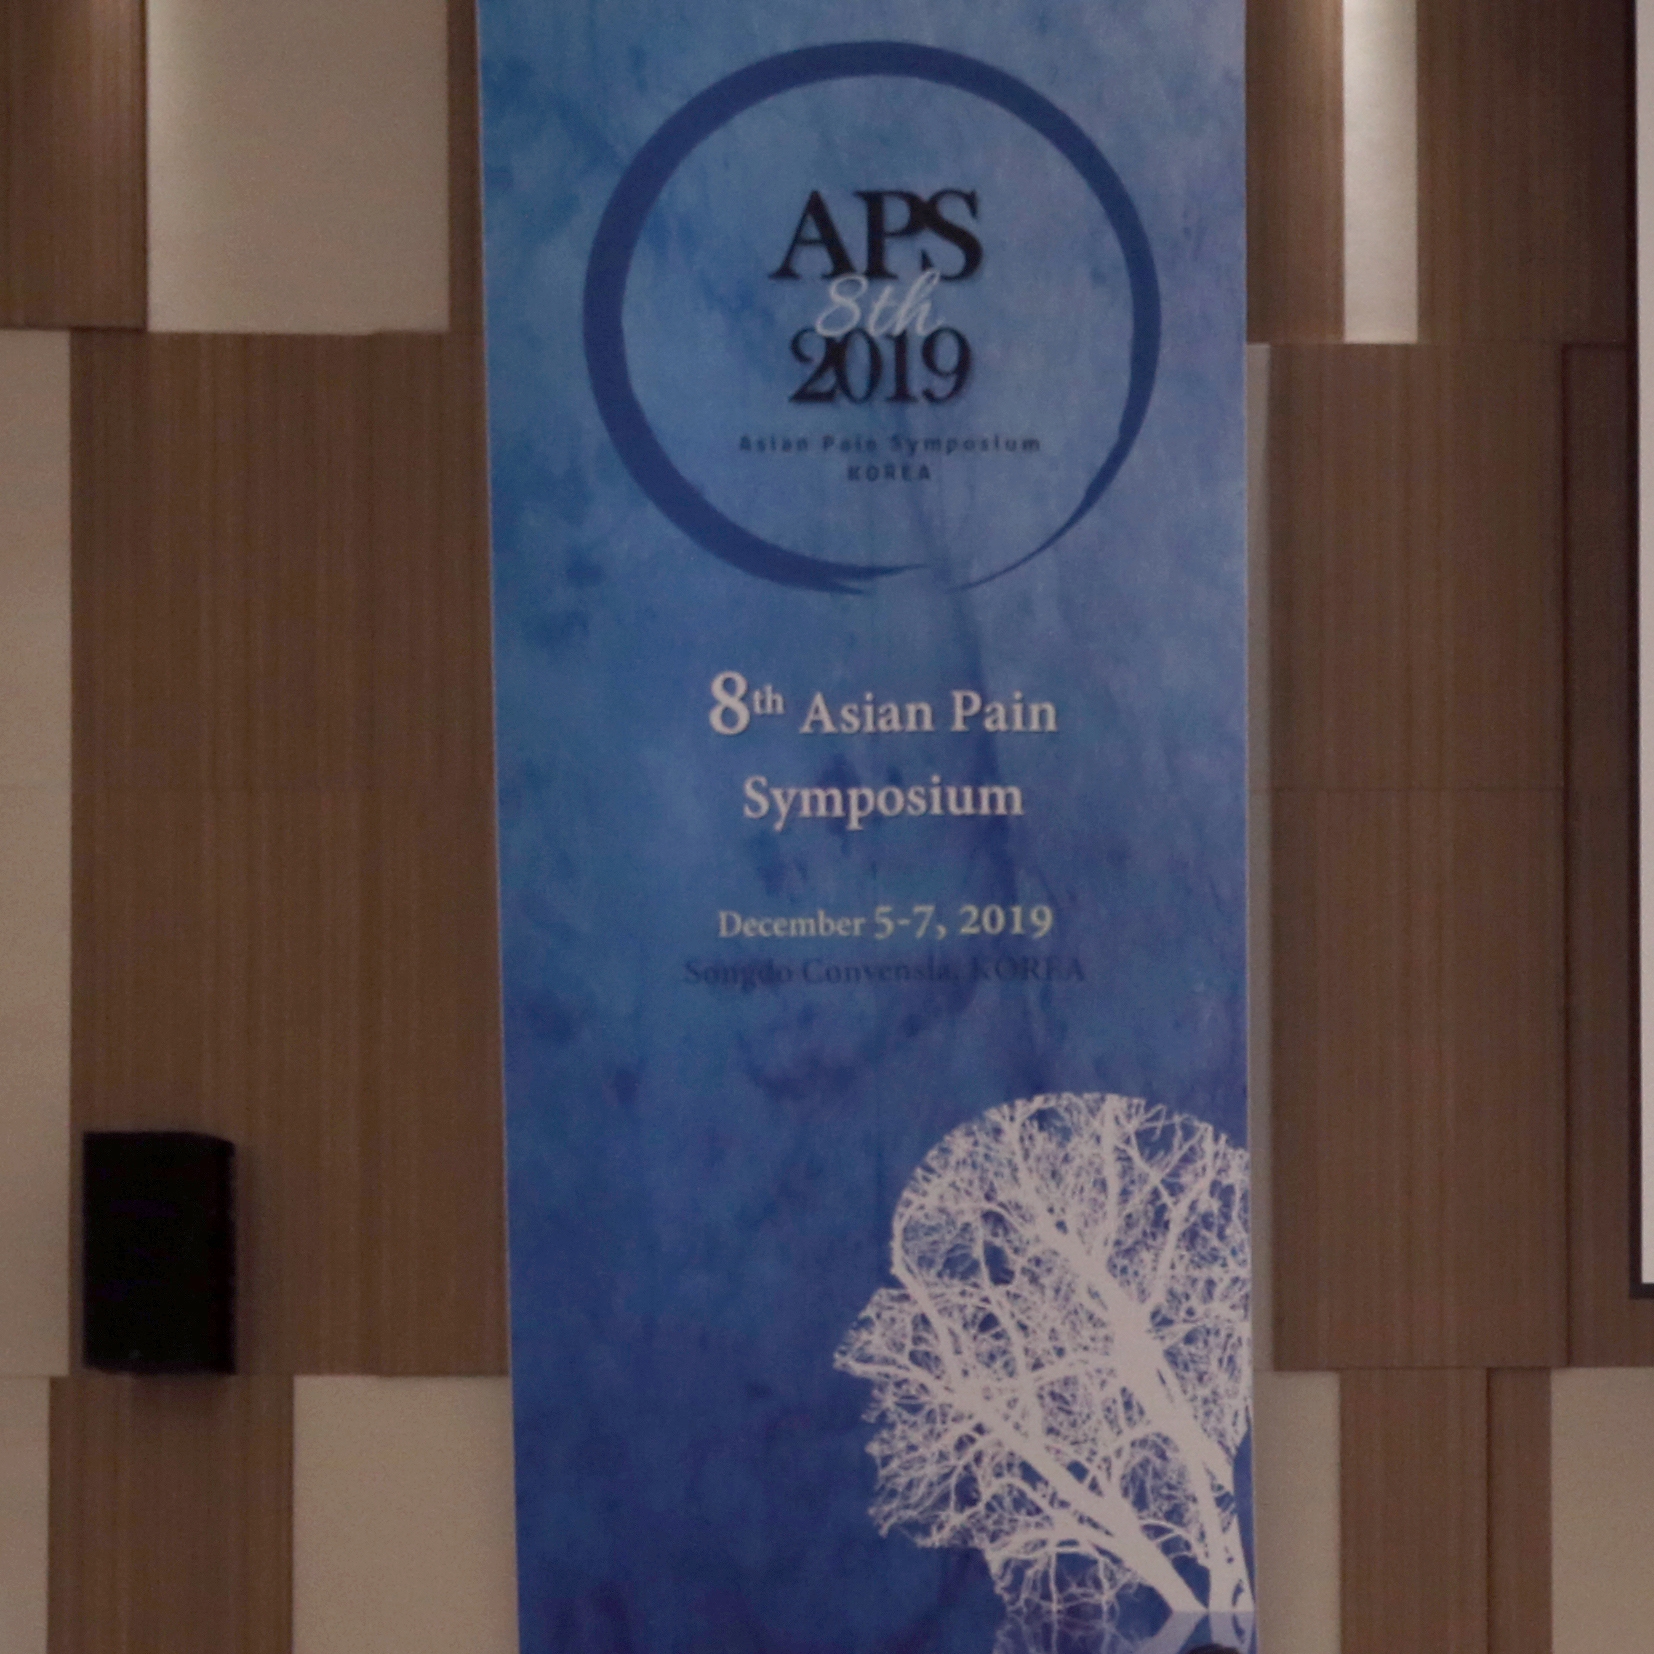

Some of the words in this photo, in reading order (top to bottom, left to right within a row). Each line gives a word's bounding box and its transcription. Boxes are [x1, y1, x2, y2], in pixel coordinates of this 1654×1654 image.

[769, 188, 984, 281] APS
[816, 268, 945, 339] 8th
[788, 328, 971, 403] 2019
[739, 433, 809, 453] Asian
[822, 433, 878, 453] Pain
[891, 433, 1041, 457] Symposium
[847, 464, 932, 483] KOREA
[709, 671, 785, 736] 8th
[800, 691, 934, 735] Asian
[949, 690, 1058, 733] Pain
[743, 774, 1023, 831] Symposium
[718, 909, 864, 940] December
[874, 905, 947, 942] 5-7,
[959, 904, 1053, 937] 2019
[684, 958, 793, 990] Songdo
[971, 956, 1087, 984] KOREA
